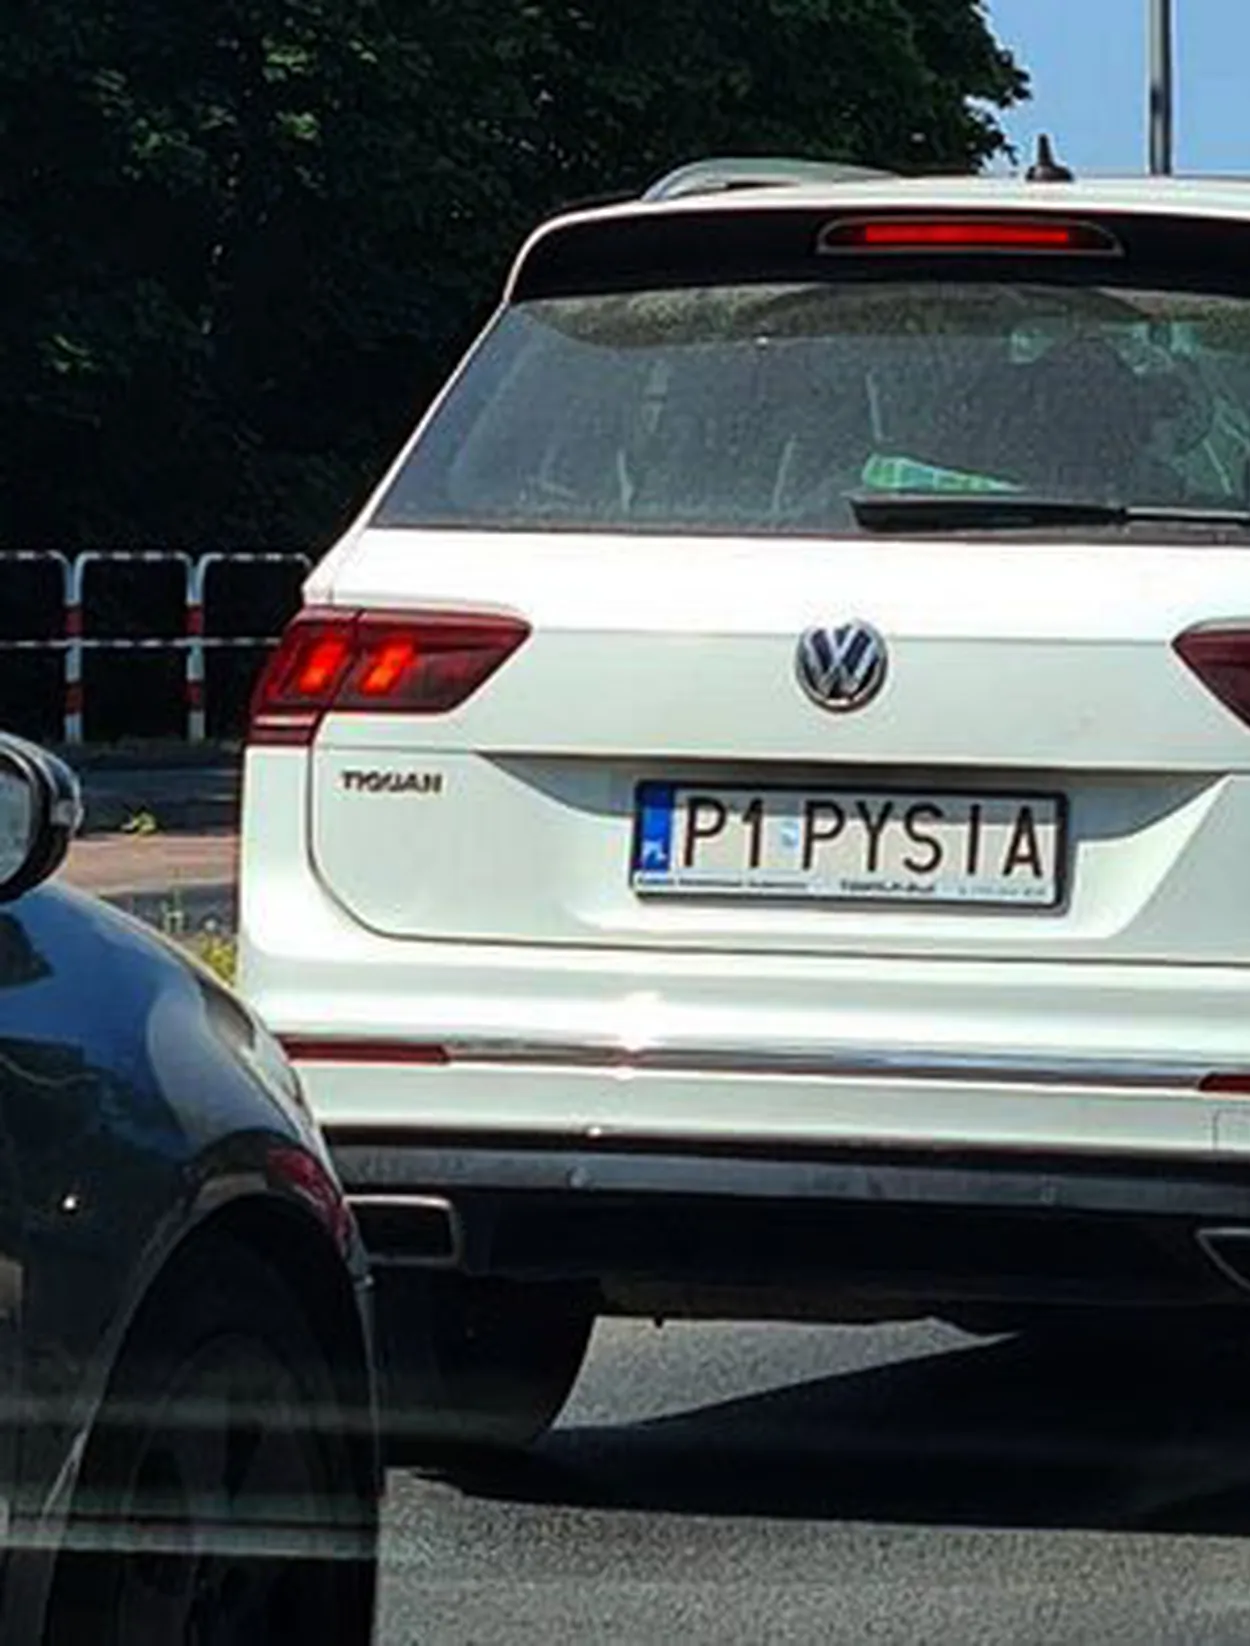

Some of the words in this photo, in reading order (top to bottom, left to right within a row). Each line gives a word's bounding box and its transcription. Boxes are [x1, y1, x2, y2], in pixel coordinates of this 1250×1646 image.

[341, 770, 443, 794] TIGUAN
[683, 796, 764, 869] P1
[802, 799, 1043, 879] PYSIA
